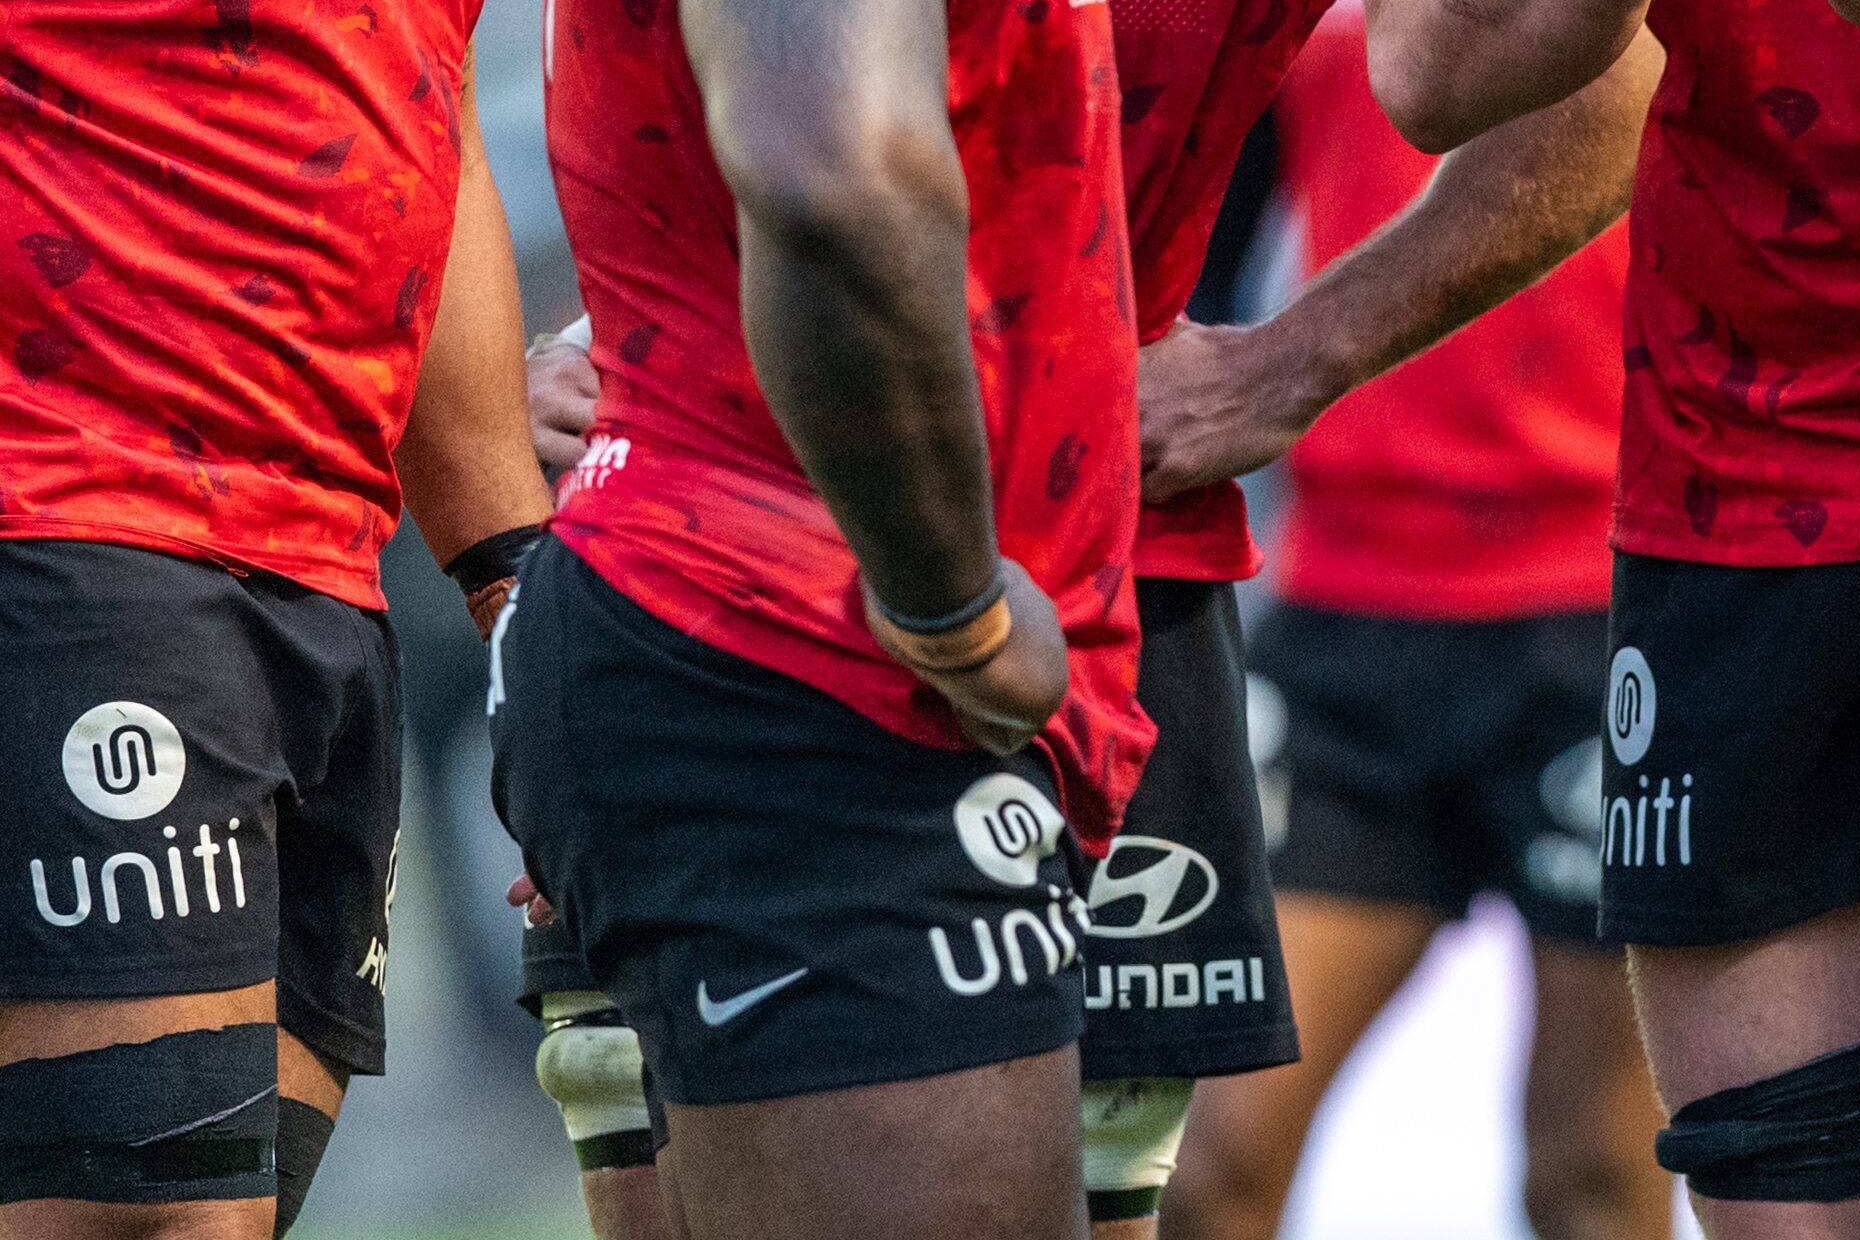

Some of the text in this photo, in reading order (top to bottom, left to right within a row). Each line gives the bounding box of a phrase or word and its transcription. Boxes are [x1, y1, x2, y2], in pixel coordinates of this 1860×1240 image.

[1601, 773, 1693, 867] niti
[30, 817, 246, 927] uniti
[1083, 957, 1265, 1010] UNDAI
